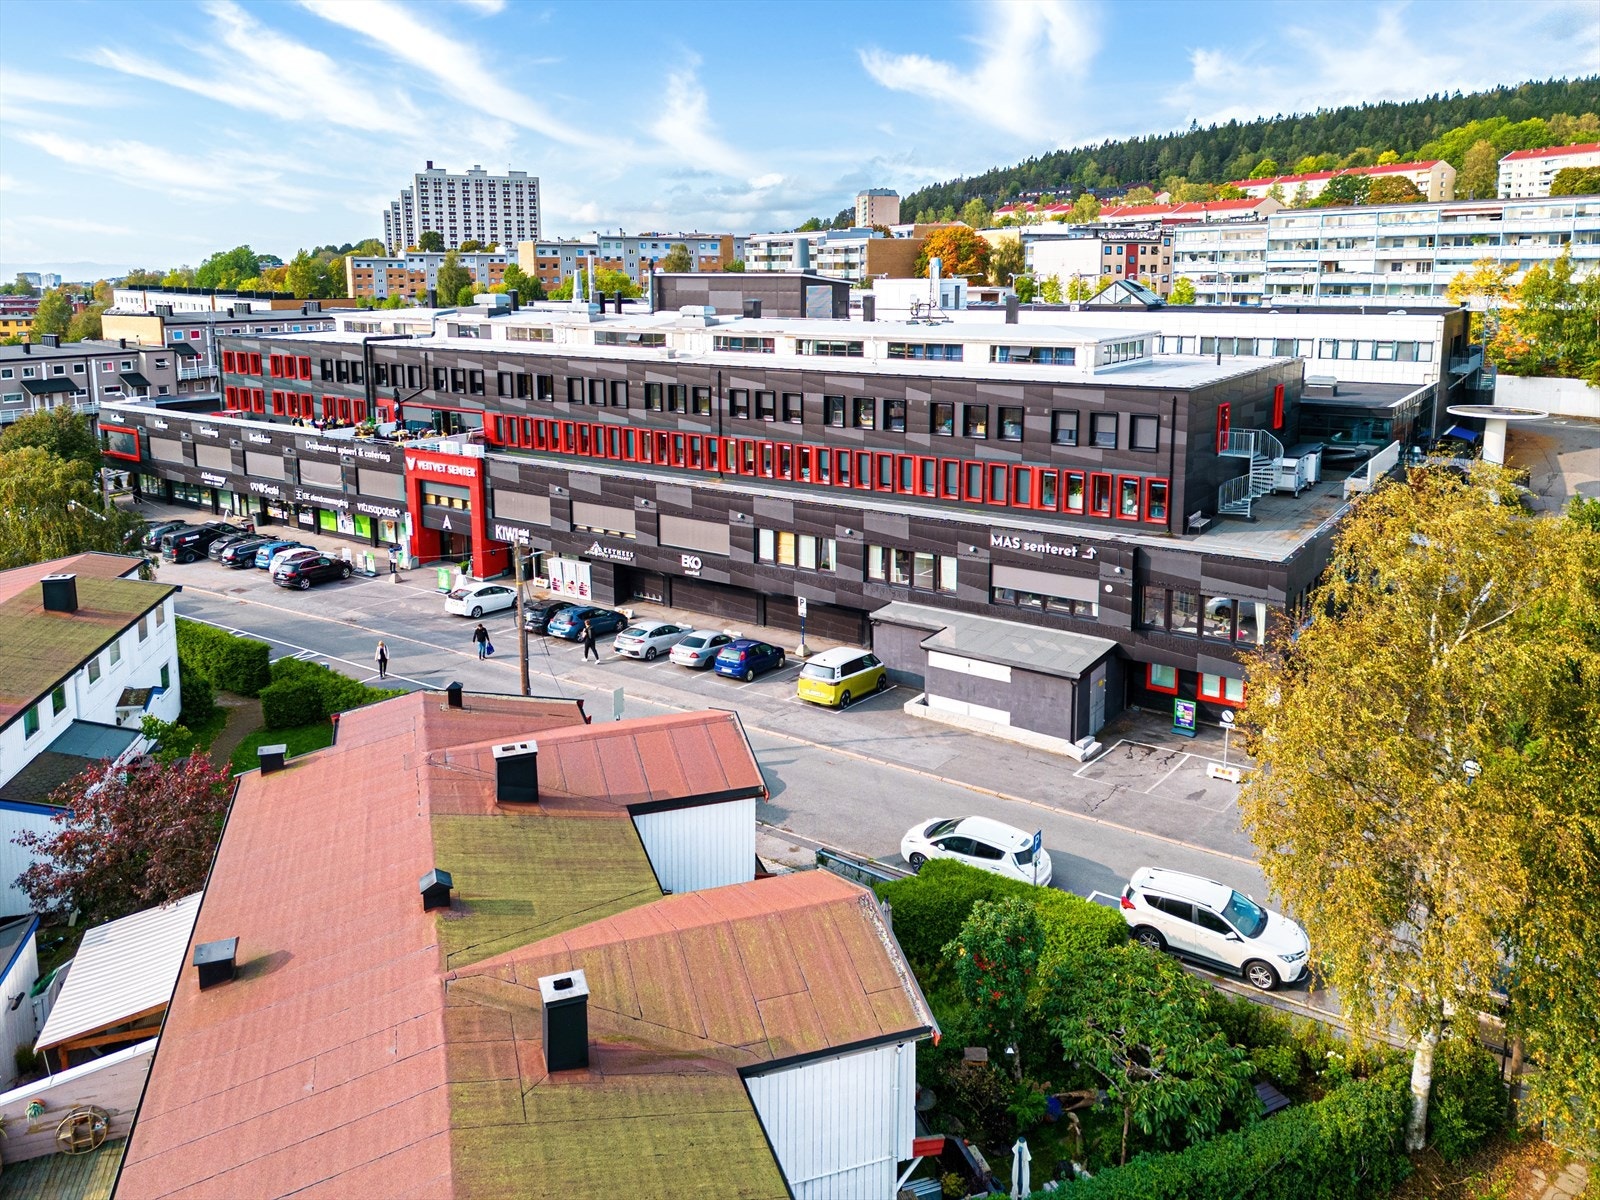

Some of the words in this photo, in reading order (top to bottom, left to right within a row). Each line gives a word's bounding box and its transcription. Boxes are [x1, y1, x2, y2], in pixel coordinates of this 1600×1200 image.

[358, 448, 364, 457] &
[364, 450, 391, 463] catering
[416, 460, 447, 473] VEITVET
[447, 465, 476, 478] SENTER
[442, 514, 453, 530] A
[495, 524, 519, 542] KIWI
[991, 534, 1021, 549] MAS
[1023, 542, 1078, 557] senteret
[681, 554, 702, 570] EKO
[800, 598, 805, 606] P
[1035, 834, 1040, 850] P
